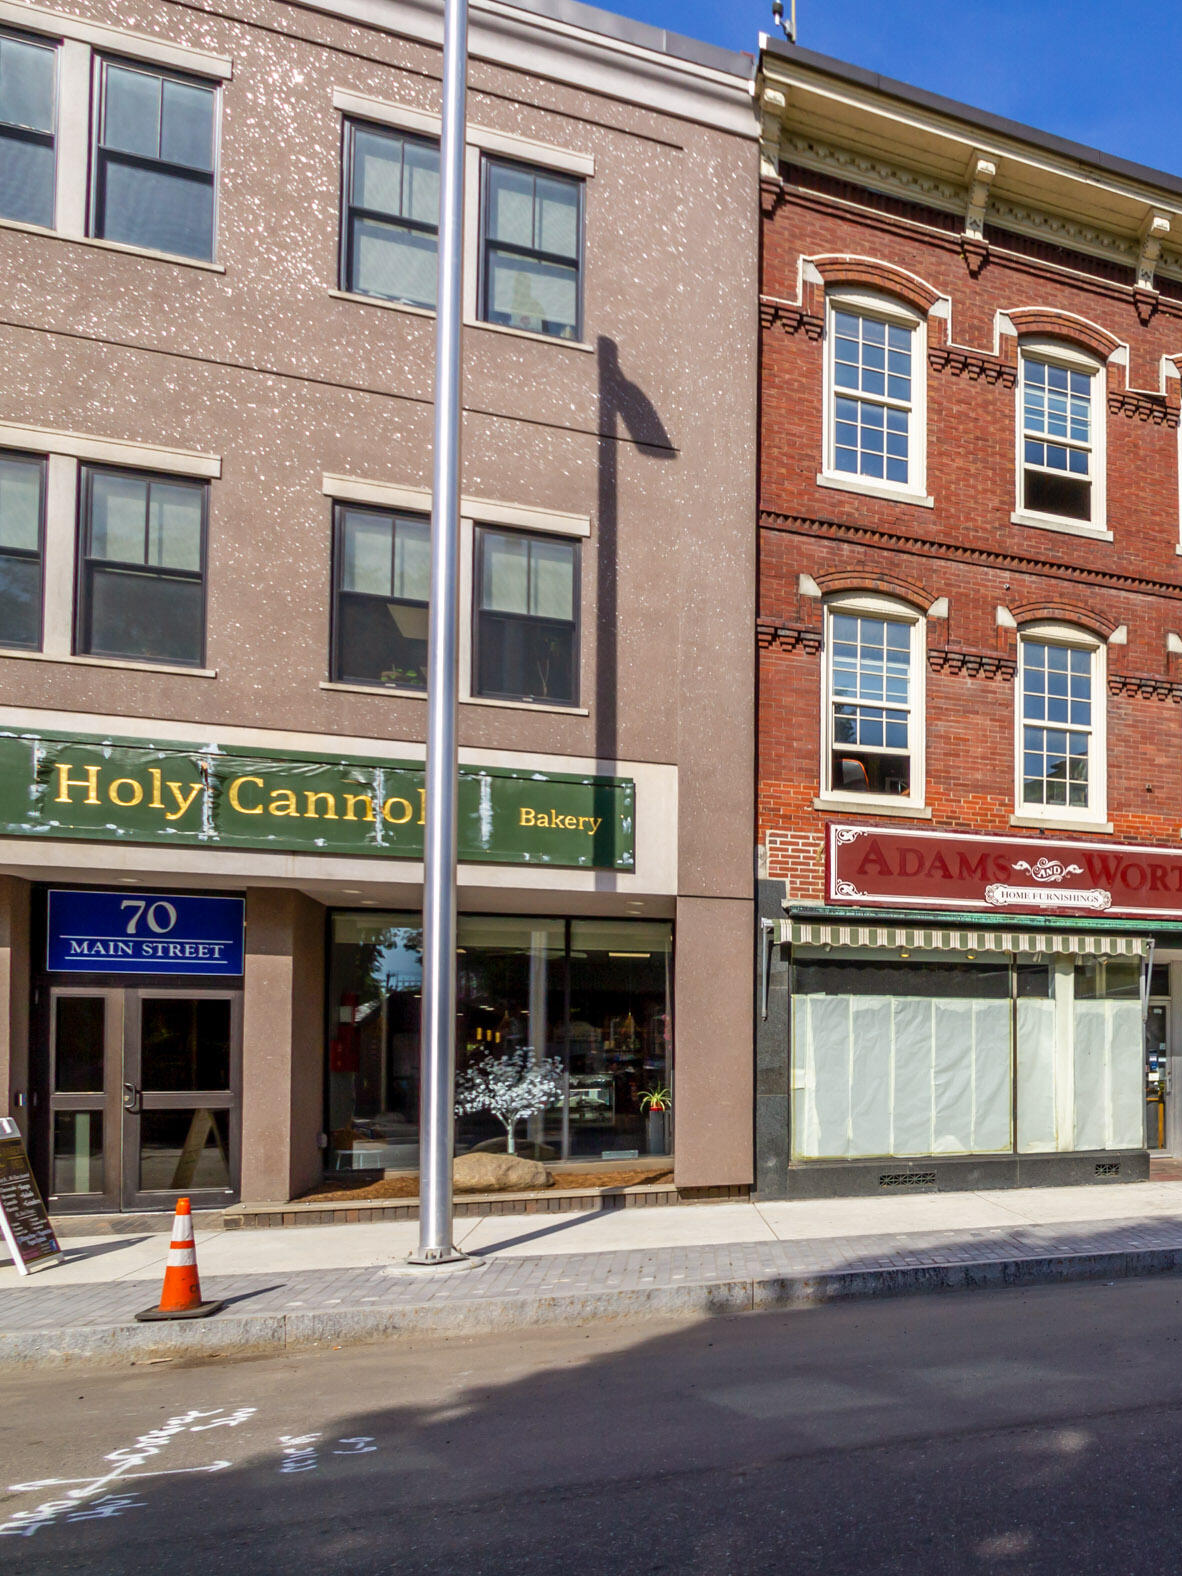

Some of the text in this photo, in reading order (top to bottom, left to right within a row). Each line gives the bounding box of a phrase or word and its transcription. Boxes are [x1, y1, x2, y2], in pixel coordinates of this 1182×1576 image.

[54, 763, 426, 825] Holy Cannol
[518, 807, 602, 835] Bakery
[856, 838, 1012, 883] ADAMS
[1036, 866, 1061, 878] AND
[1001, 890, 1099, 903] HOME FURNISHINGS
[120, 900, 177, 934] 70
[69, 940, 225, 958] MAIN STREET
